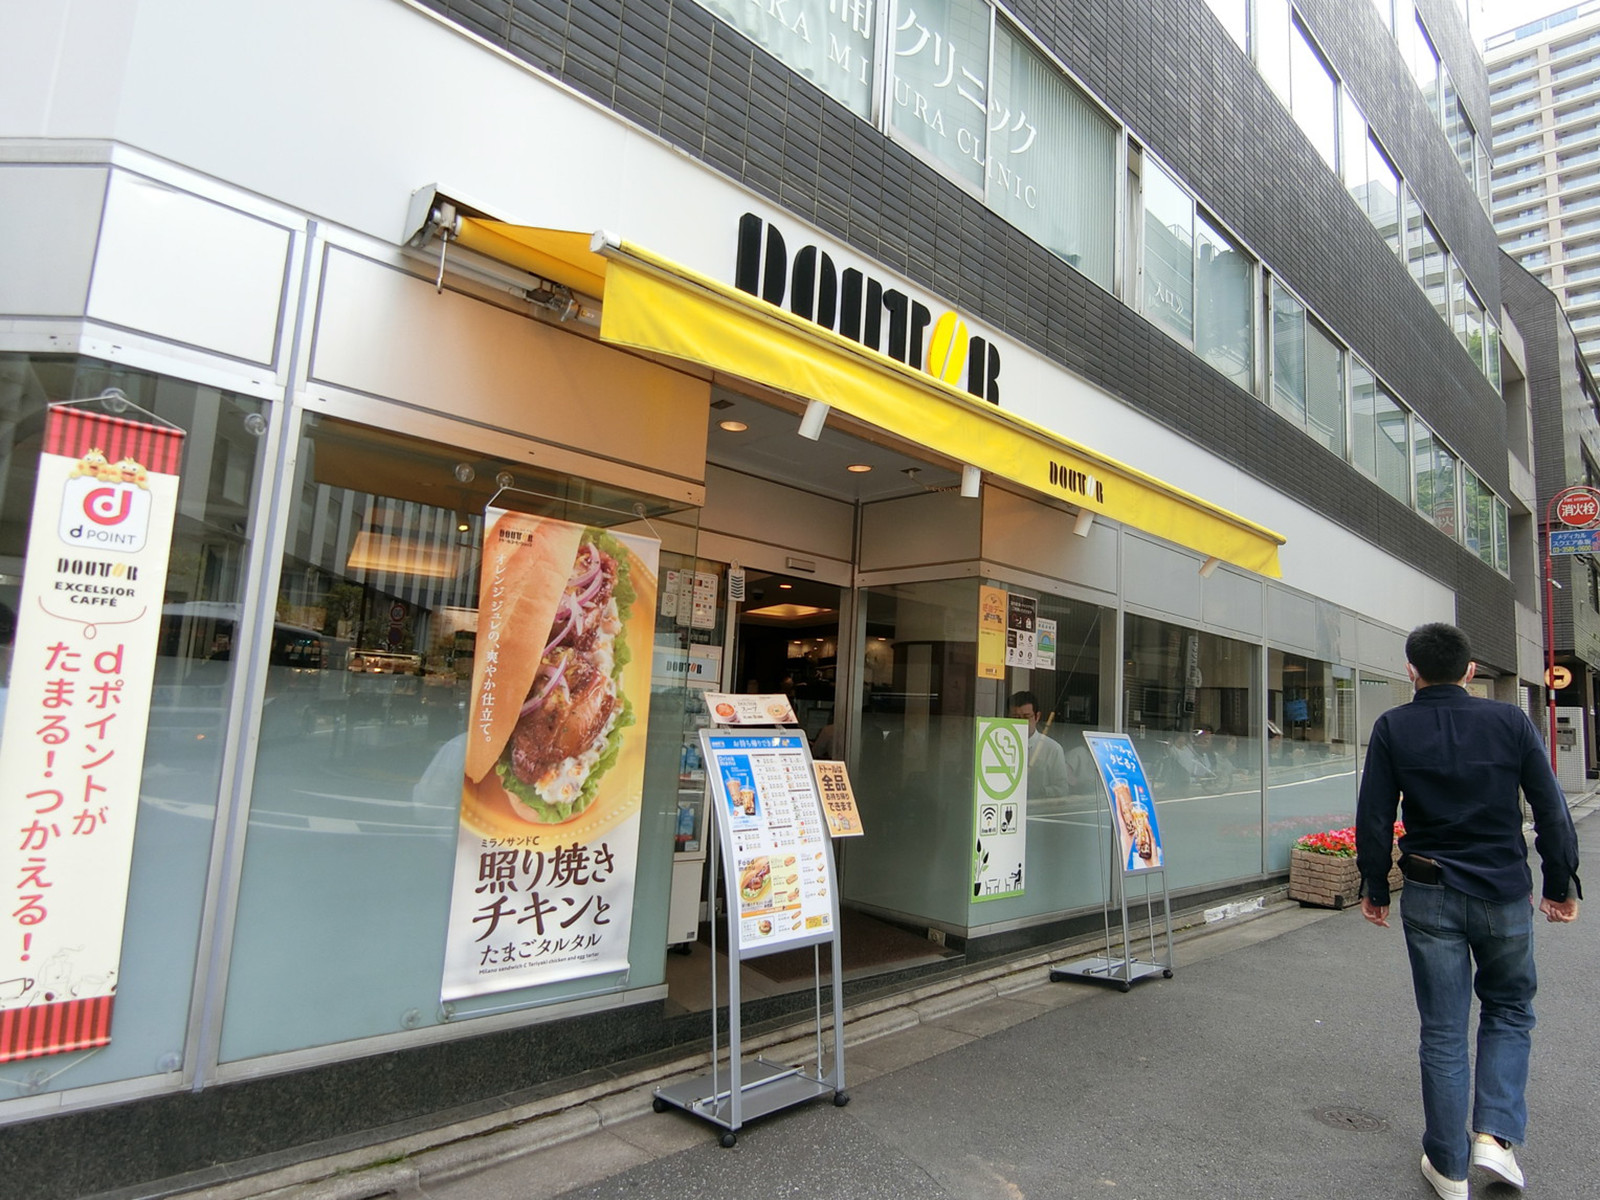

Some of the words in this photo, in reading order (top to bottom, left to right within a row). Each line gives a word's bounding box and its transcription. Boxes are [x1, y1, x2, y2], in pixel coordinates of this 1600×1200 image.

[956, 127, 1037, 210] CLINIC
[735, 212, 1001, 406] DOUTOR
[1049, 461, 1104, 504] DOUTOR
[1561, 502, 1596, 517] 消火栓
[86, 529, 137, 545] POINT
[57, 557, 138, 581] DOUTOR
[54, 581, 136, 597] EXCELSIOR
[70, 594, 118, 607] CAFFÉ
[666, 660, 703, 675] DOUTOR
[72, 643, 125, 836] dポイントが
[821, 774, 847, 791] 全品
[827, 801, 852, 811] できます
[480, 836, 540, 849] ミラノサンドC
[474, 842, 615, 894] 照り焼き
[472, 891, 611, 943] チキンと
[480, 933, 603, 966] たまごタルタル
[498, 963, 523, 972] sandwich
